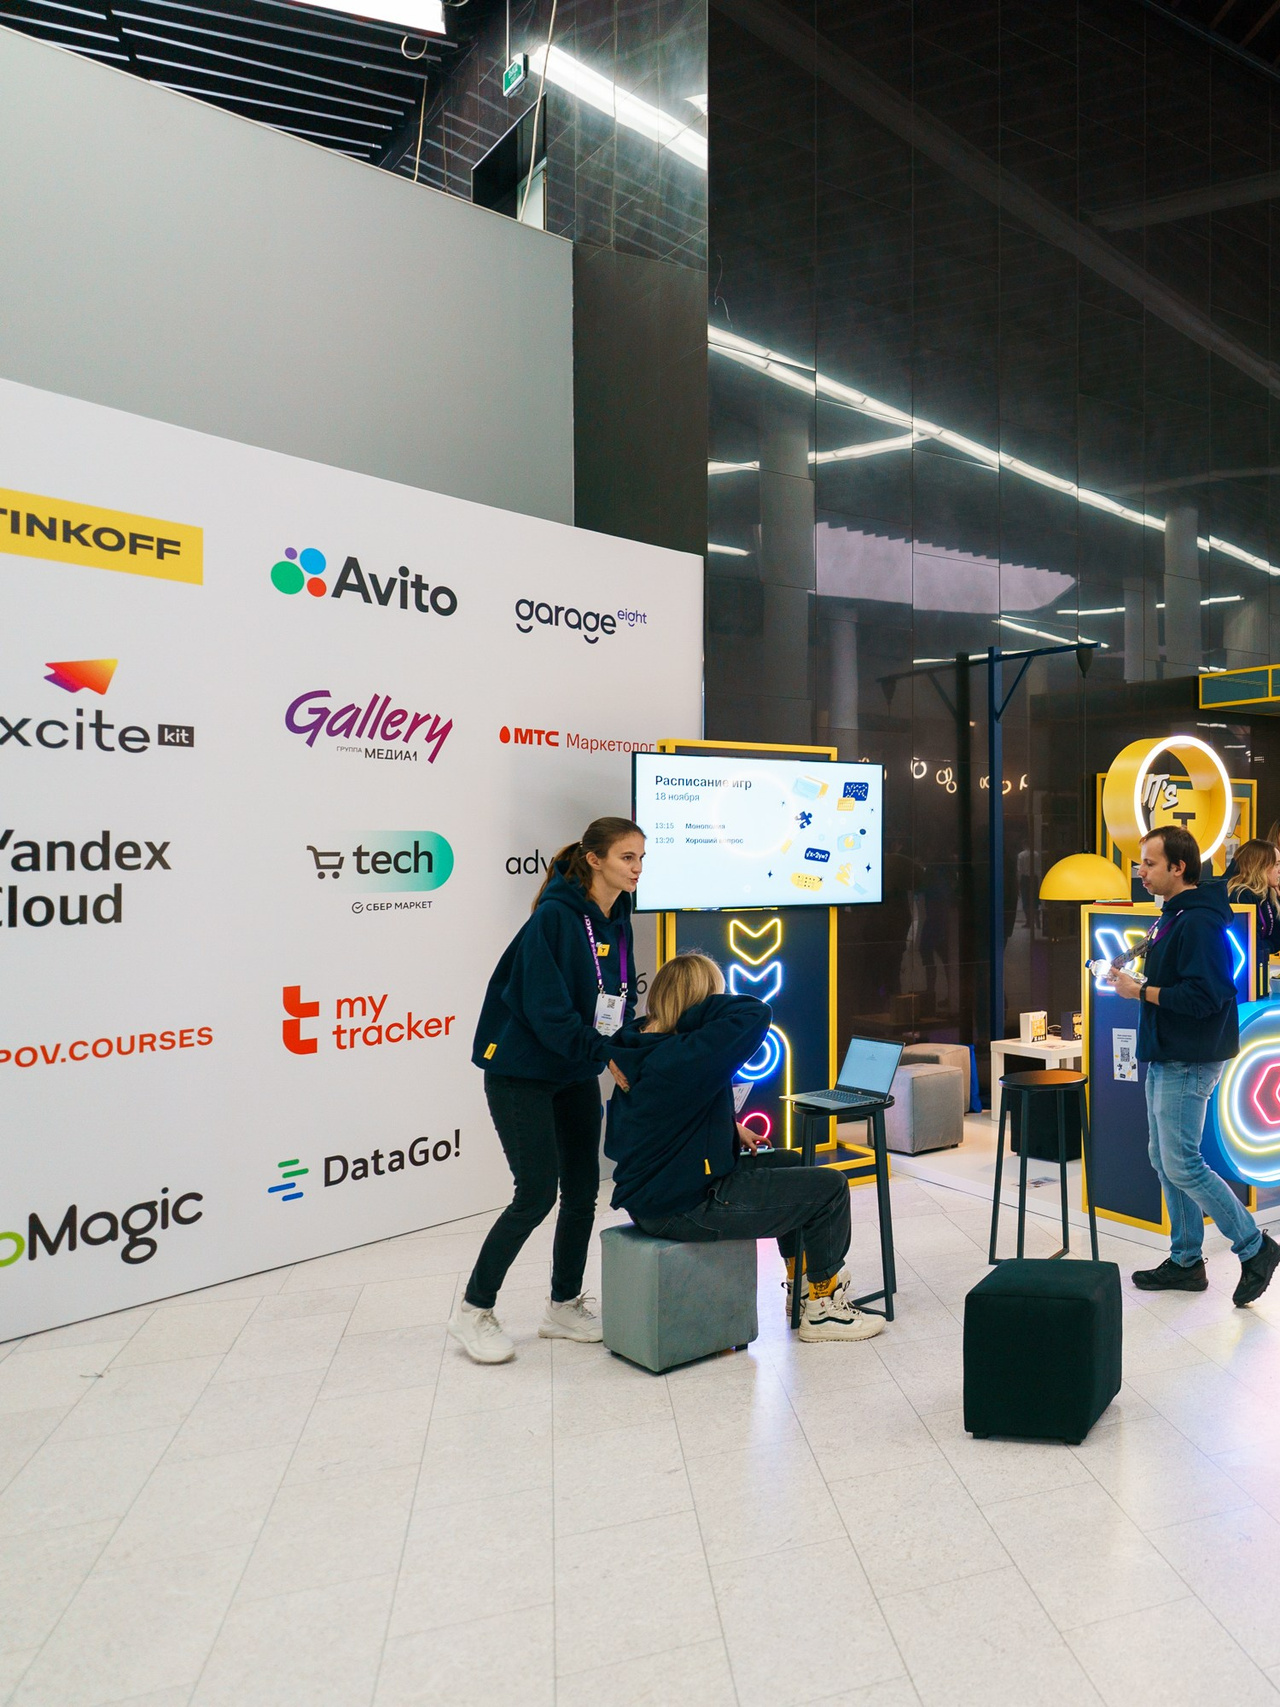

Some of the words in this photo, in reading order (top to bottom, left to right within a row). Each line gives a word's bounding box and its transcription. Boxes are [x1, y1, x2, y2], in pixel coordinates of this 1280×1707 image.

[331, 556, 458, 616] Avito
[515, 598, 617, 644] garage
[616, 608, 647, 627] eight
[164, 728, 189, 744] kit
[285, 690, 453, 764] Gallery
[514, 727, 559, 747] МТС
[336, 745, 362, 753] ГРУППА
[365, 748, 418, 762] МЕДИА1
[655, 775, 729, 788] Расписание
[732, 779, 752, 791] игр
[655, 792, 667, 801] 18
[668, 792, 700, 802] ноября
[685, 837, 718, 845] Хороший
[719, 837, 744, 845] впрос
[353, 841, 433, 875] tech
[0, 883, 122, 928] loud
[366, 902, 393, 911] СБЕР
[394, 900, 433, 910] МАРКЕТ
[336, 994, 388, 1023] my
[332, 1012, 456, 1050] tracker
[324, 1129, 460, 1187] DataGo!
